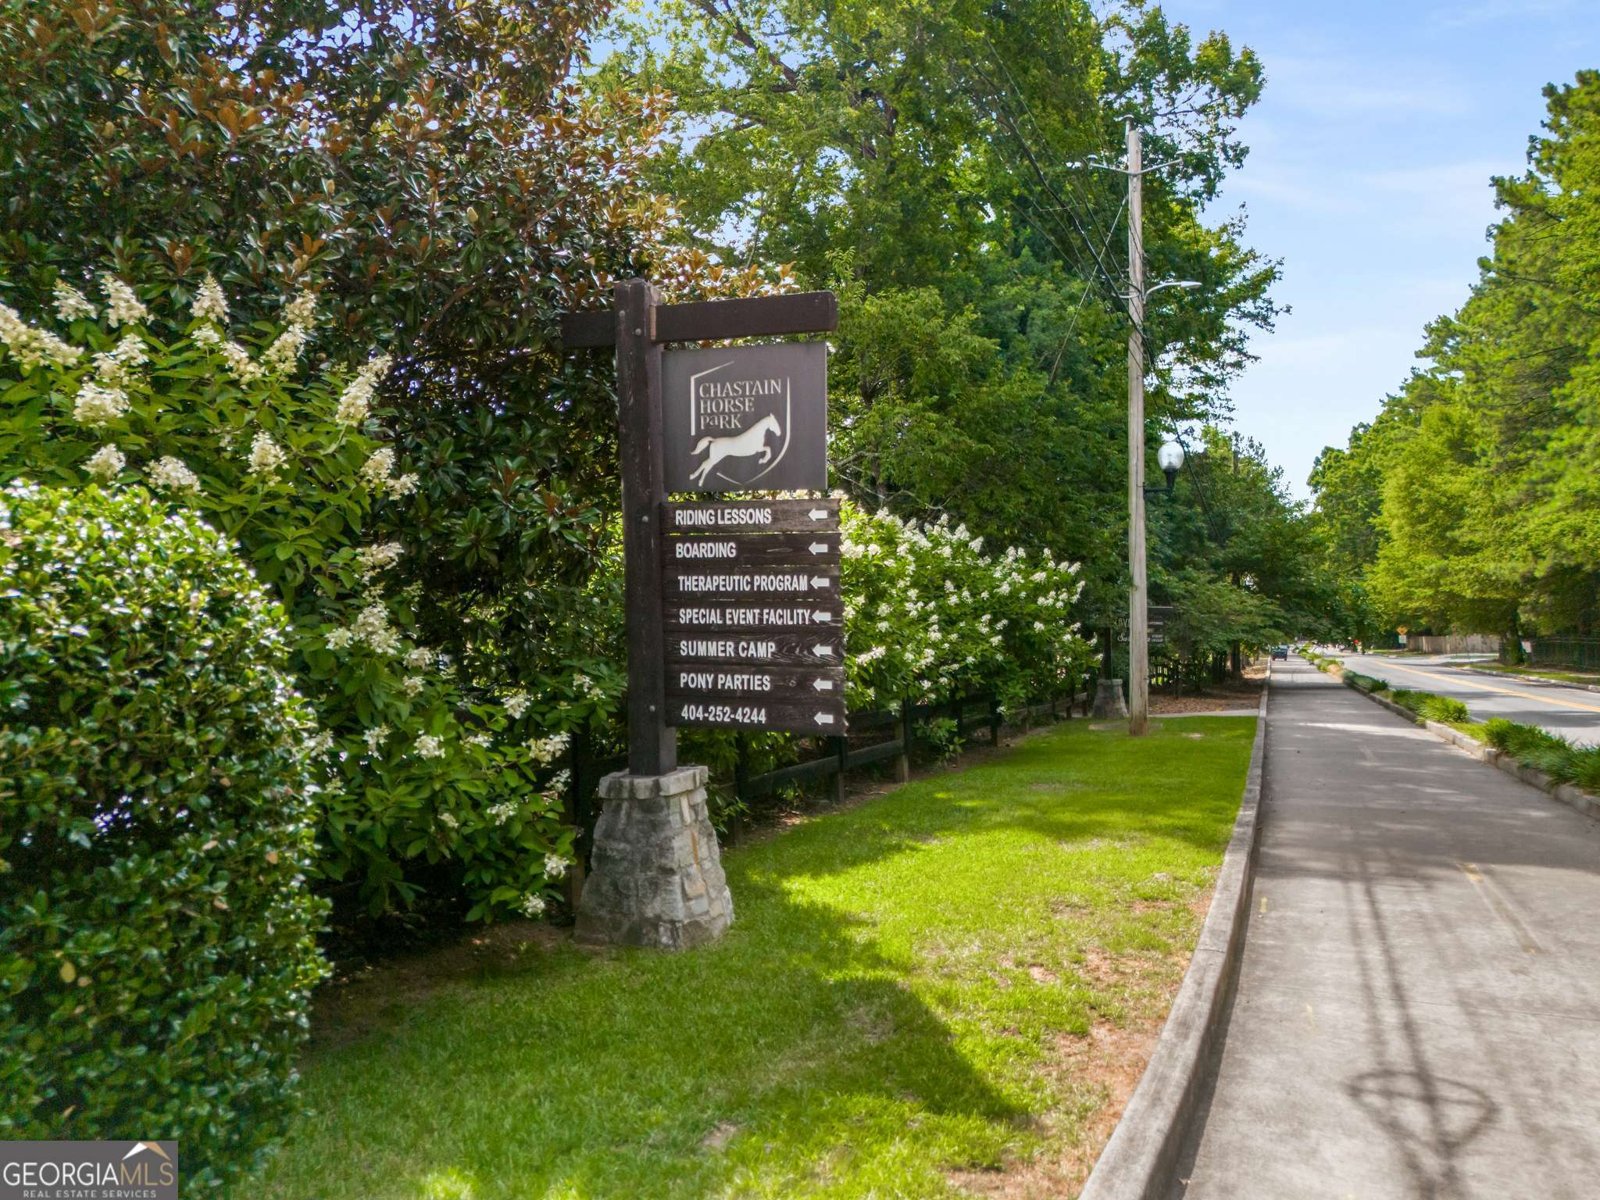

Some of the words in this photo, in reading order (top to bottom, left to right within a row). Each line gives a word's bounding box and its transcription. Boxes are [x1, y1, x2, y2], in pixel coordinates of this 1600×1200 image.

[699, 379, 782, 398] CHASTAIN
[700, 397, 755, 414] HORSE
[675, 509, 716, 526] RIDING
[717, 508, 772, 525] LESSONS
[675, 542, 737, 558] BOARDING
[678, 575, 751, 591] THERAPEUTIC
[753, 574, 808, 591] PROGRAM
[679, 608, 723, 624] SPECIAL
[726, 608, 760, 624] EVENT
[763, 608, 811, 625] FACILITY
[680, 640, 735, 657] SUMMER
[738, 641, 776, 658] CAMP
[680, 673, 713, 688] PONY
[717, 674, 771, 691] PARTIES
[681, 704, 767, 724] 404-252-4244
